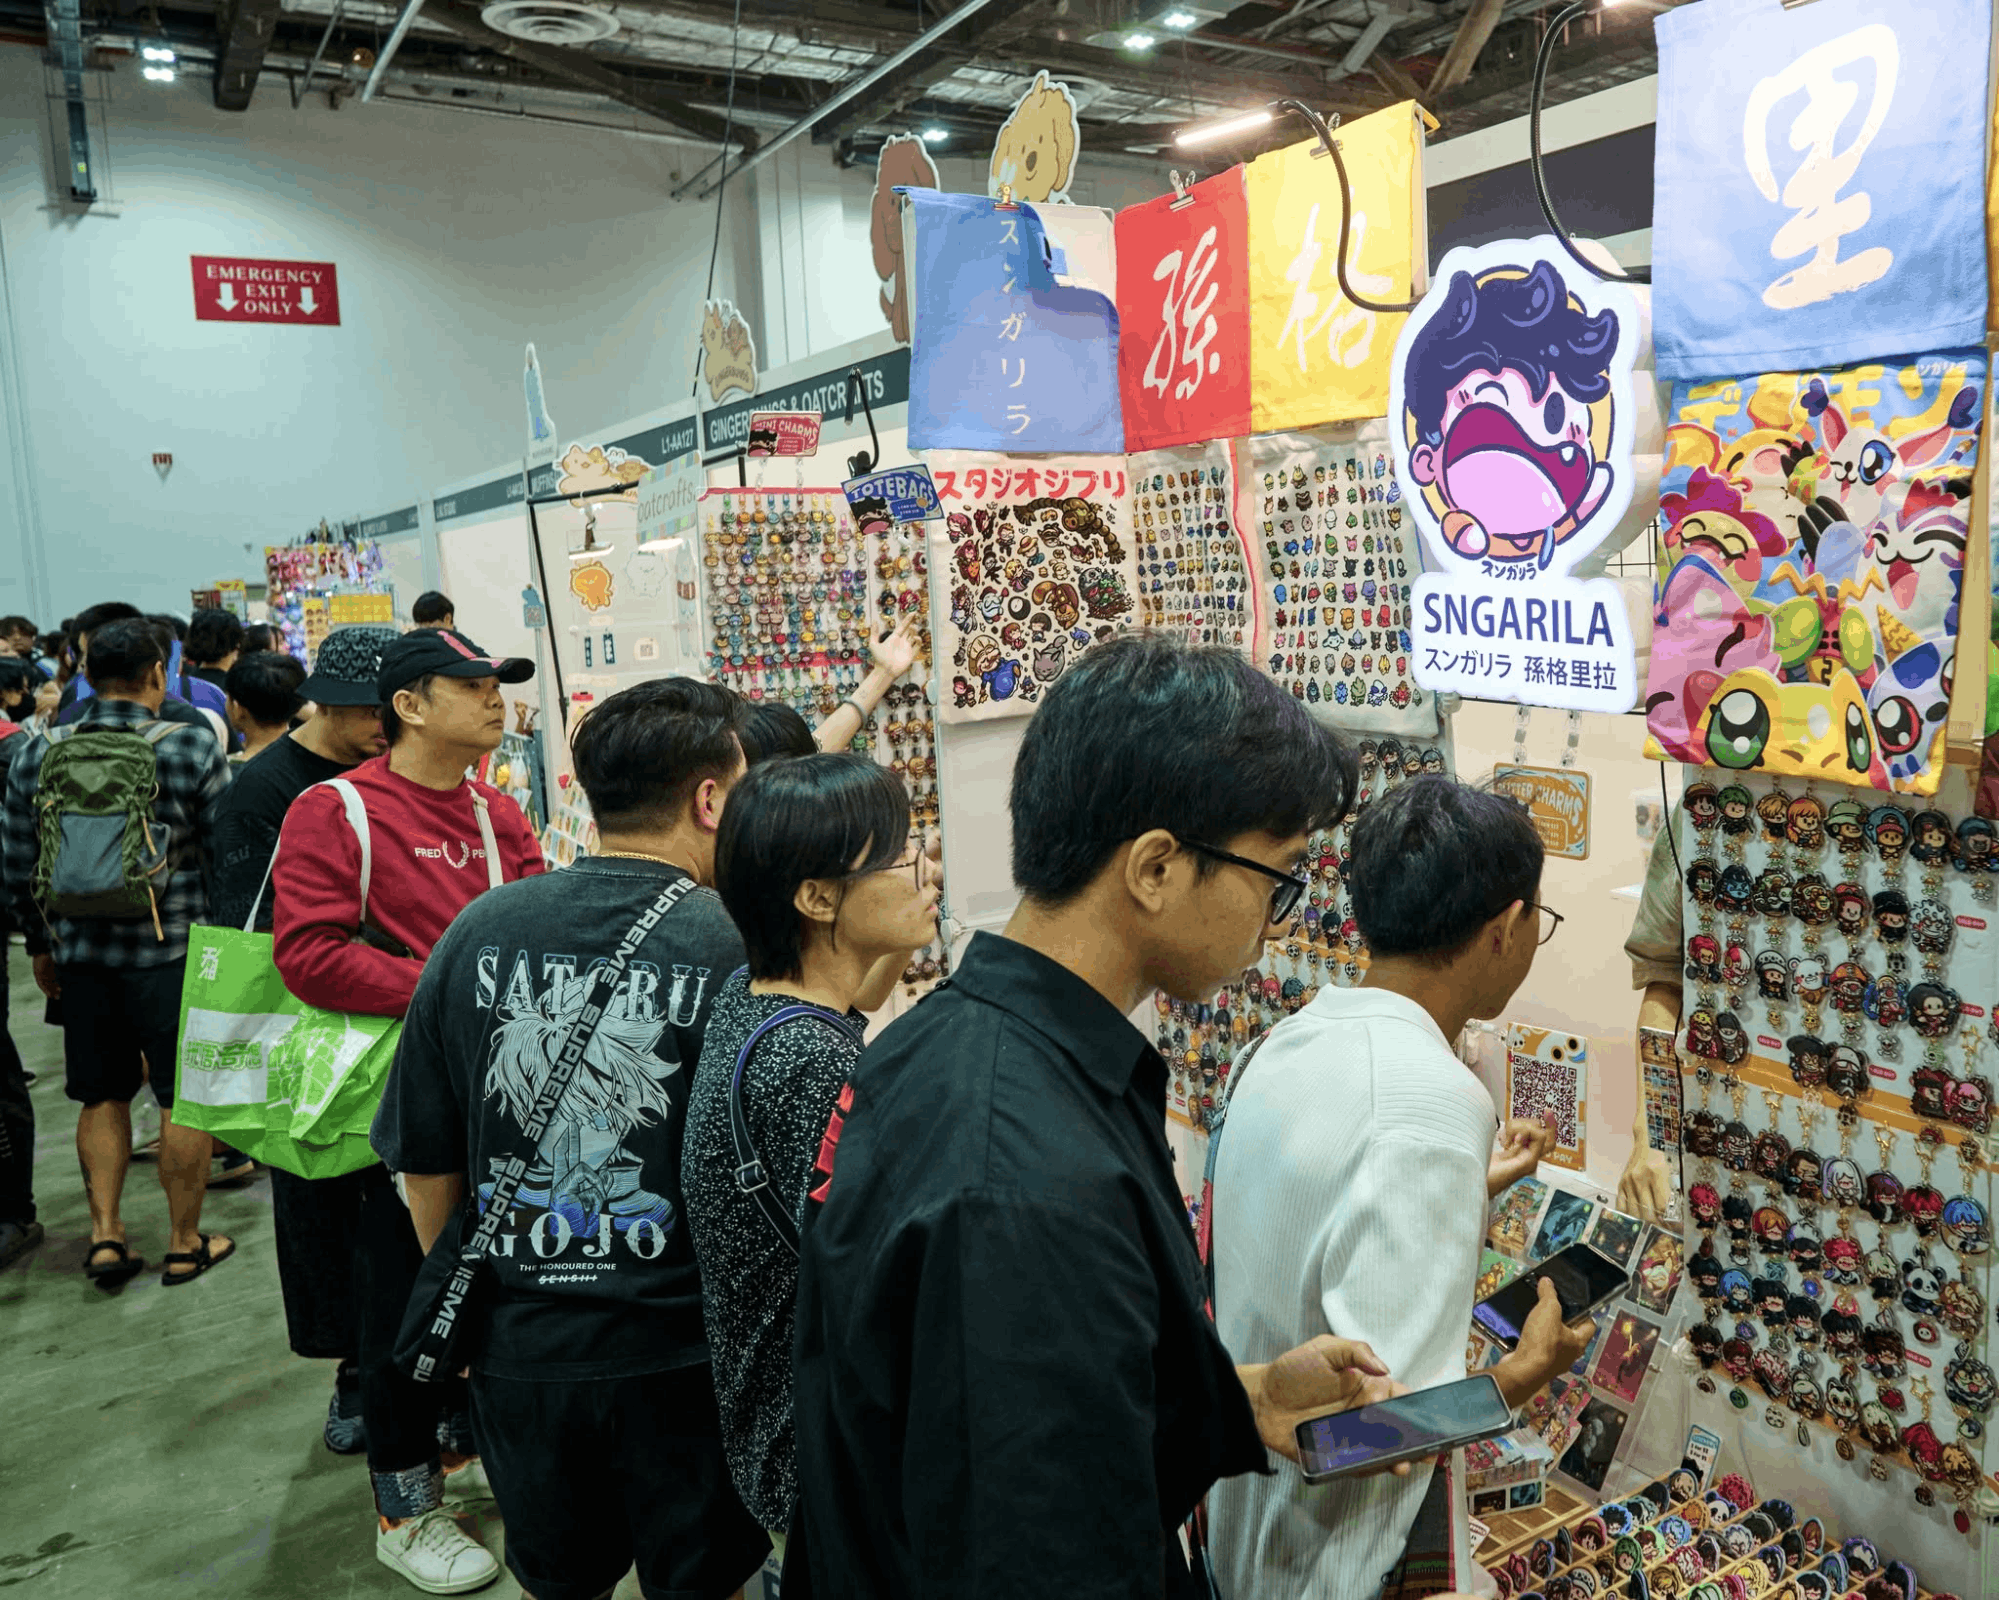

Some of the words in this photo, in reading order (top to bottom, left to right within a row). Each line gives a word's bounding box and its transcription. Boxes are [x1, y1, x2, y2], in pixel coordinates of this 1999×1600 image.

[1743, 23, 1900, 310] 里
[206, 264, 322, 285] EMERGENCY
[246, 283, 288, 298] EXIT
[244, 300, 292, 316] ONLY
[999, 219, 1031, 436] スンガリラ
[661, 428, 694, 454] L1-AA127
[779, 420, 819, 445] CHARMS
[851, 476, 934, 505] TOTEBAGS
[934, 467, 1126, 500] スタジオジブリ
[1481, 561, 1537, 581] スンガリラ
[1424, 592, 1615, 647] SNGARILA
[1425, 648, 1512, 678] スンガリラ
[1524, 655, 1617, 691] 孫格里拉
[1535, 785, 1583, 827] CHARMS
[414, 847, 441, 858] FRED
[600, 877, 698, 988] SUPREME
[523, 1003, 601, 1142] SUPREME
[519, 1264, 537, 1272] THE
[540, 1262, 594, 1271] HONOURED
[596, 1263, 617, 1271] ONE
